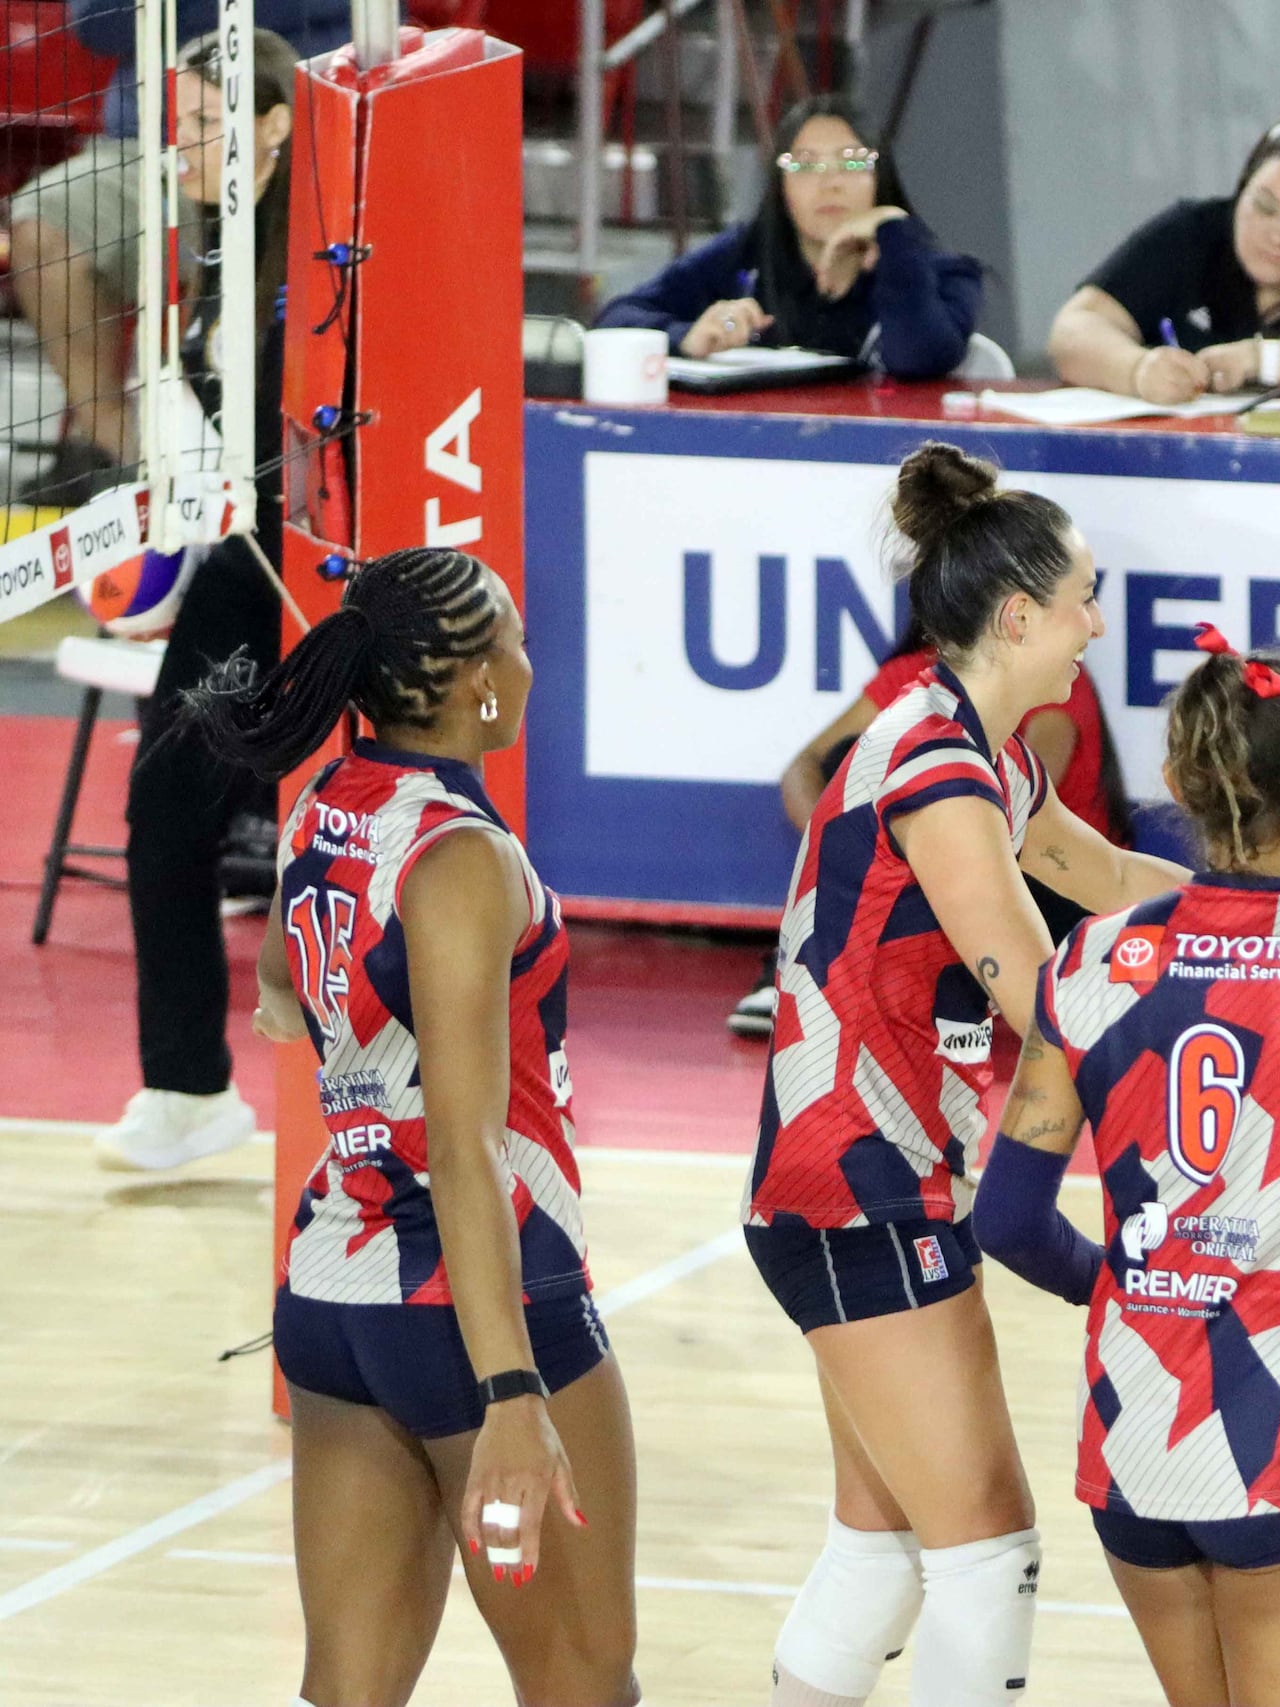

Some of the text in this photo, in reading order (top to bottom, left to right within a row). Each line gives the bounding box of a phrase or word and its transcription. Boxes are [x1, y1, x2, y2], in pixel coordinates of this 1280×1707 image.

[77, 517, 126, 559] TOYOTA
[1168, 961, 1247, 981] Financial
[1168, 1023, 1246, 1187] 6
[1125, 1267, 1239, 1304] REMIER
[1126, 1301, 1169, 1315] surance
